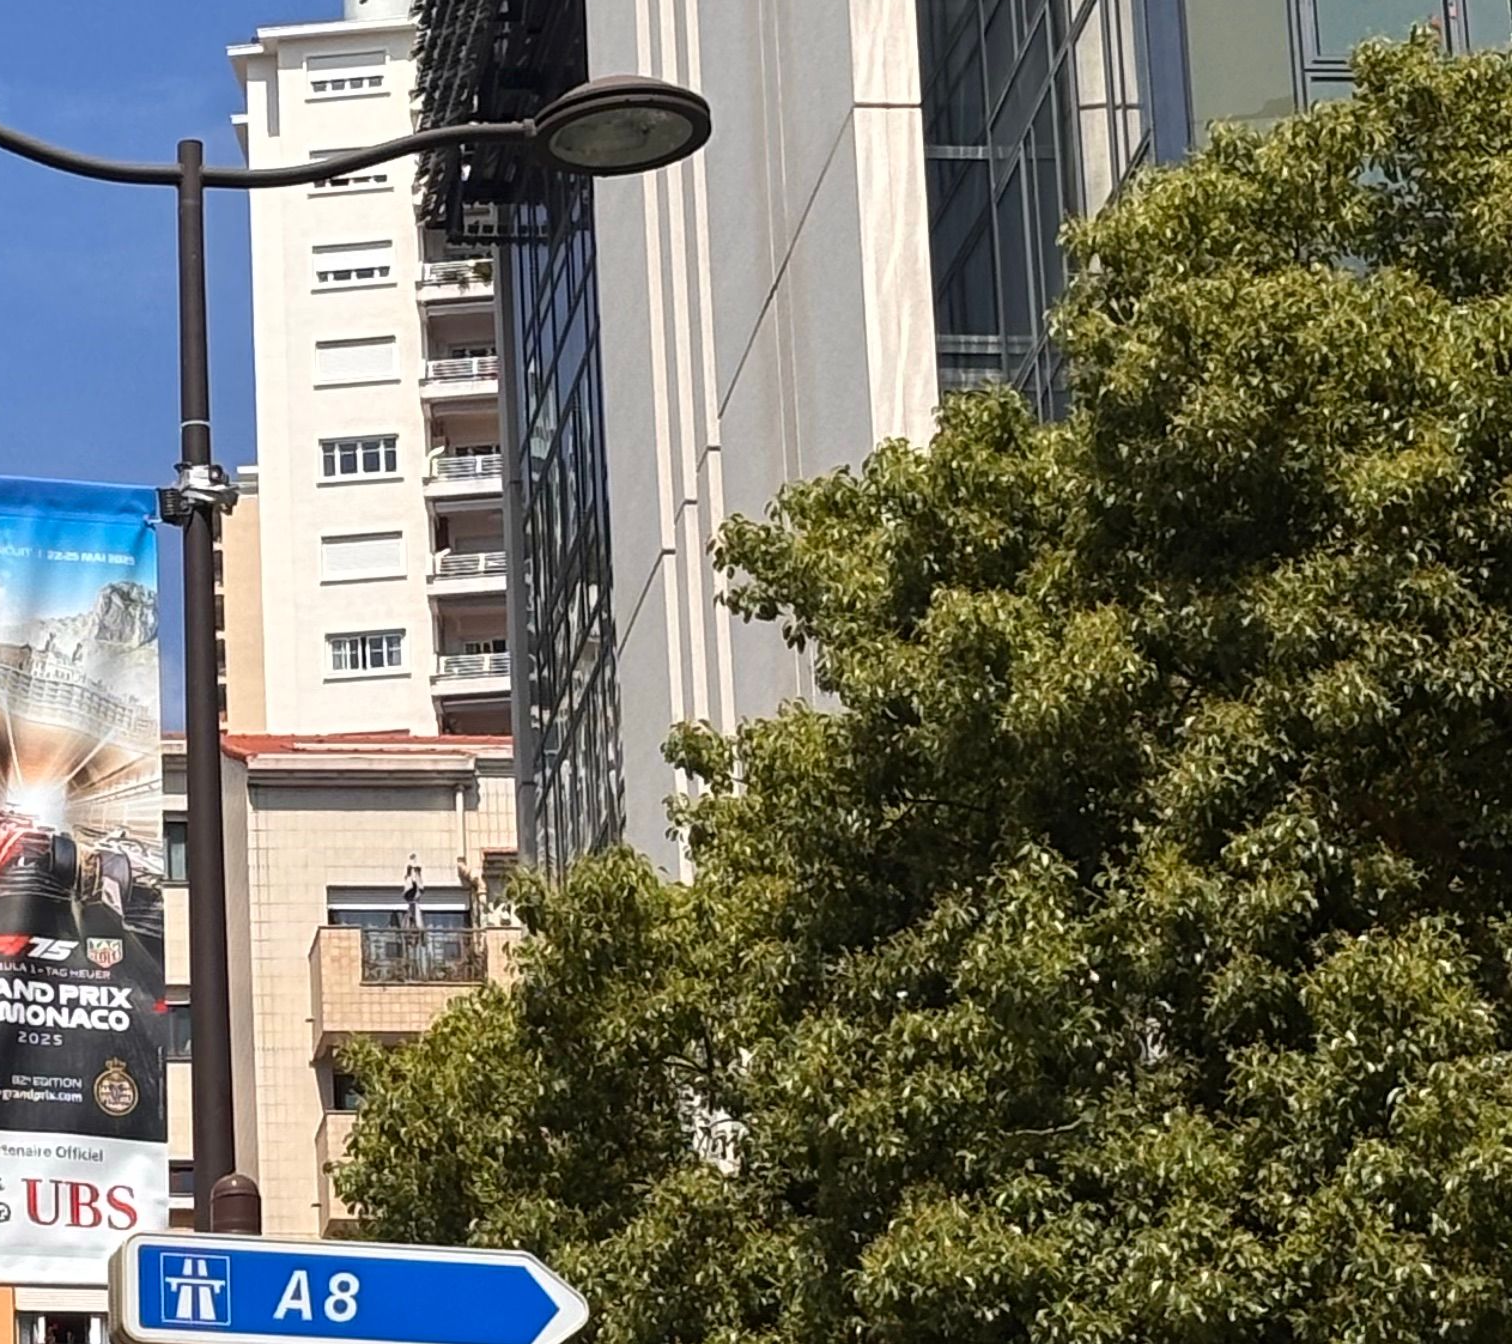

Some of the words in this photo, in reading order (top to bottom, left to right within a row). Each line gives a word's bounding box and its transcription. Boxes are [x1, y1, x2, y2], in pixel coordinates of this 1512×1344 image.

[46, 966, 68, 977] TAG
[70, 969, 111, 979] HEUER
[58, 983, 133, 1009] PRIX
[17, 1031, 63, 1046] 2025
[56, 1146, 104, 1162] Officiel
[21, 1178, 138, 1231] UBS
[273, 1269, 361, 1323] A8
